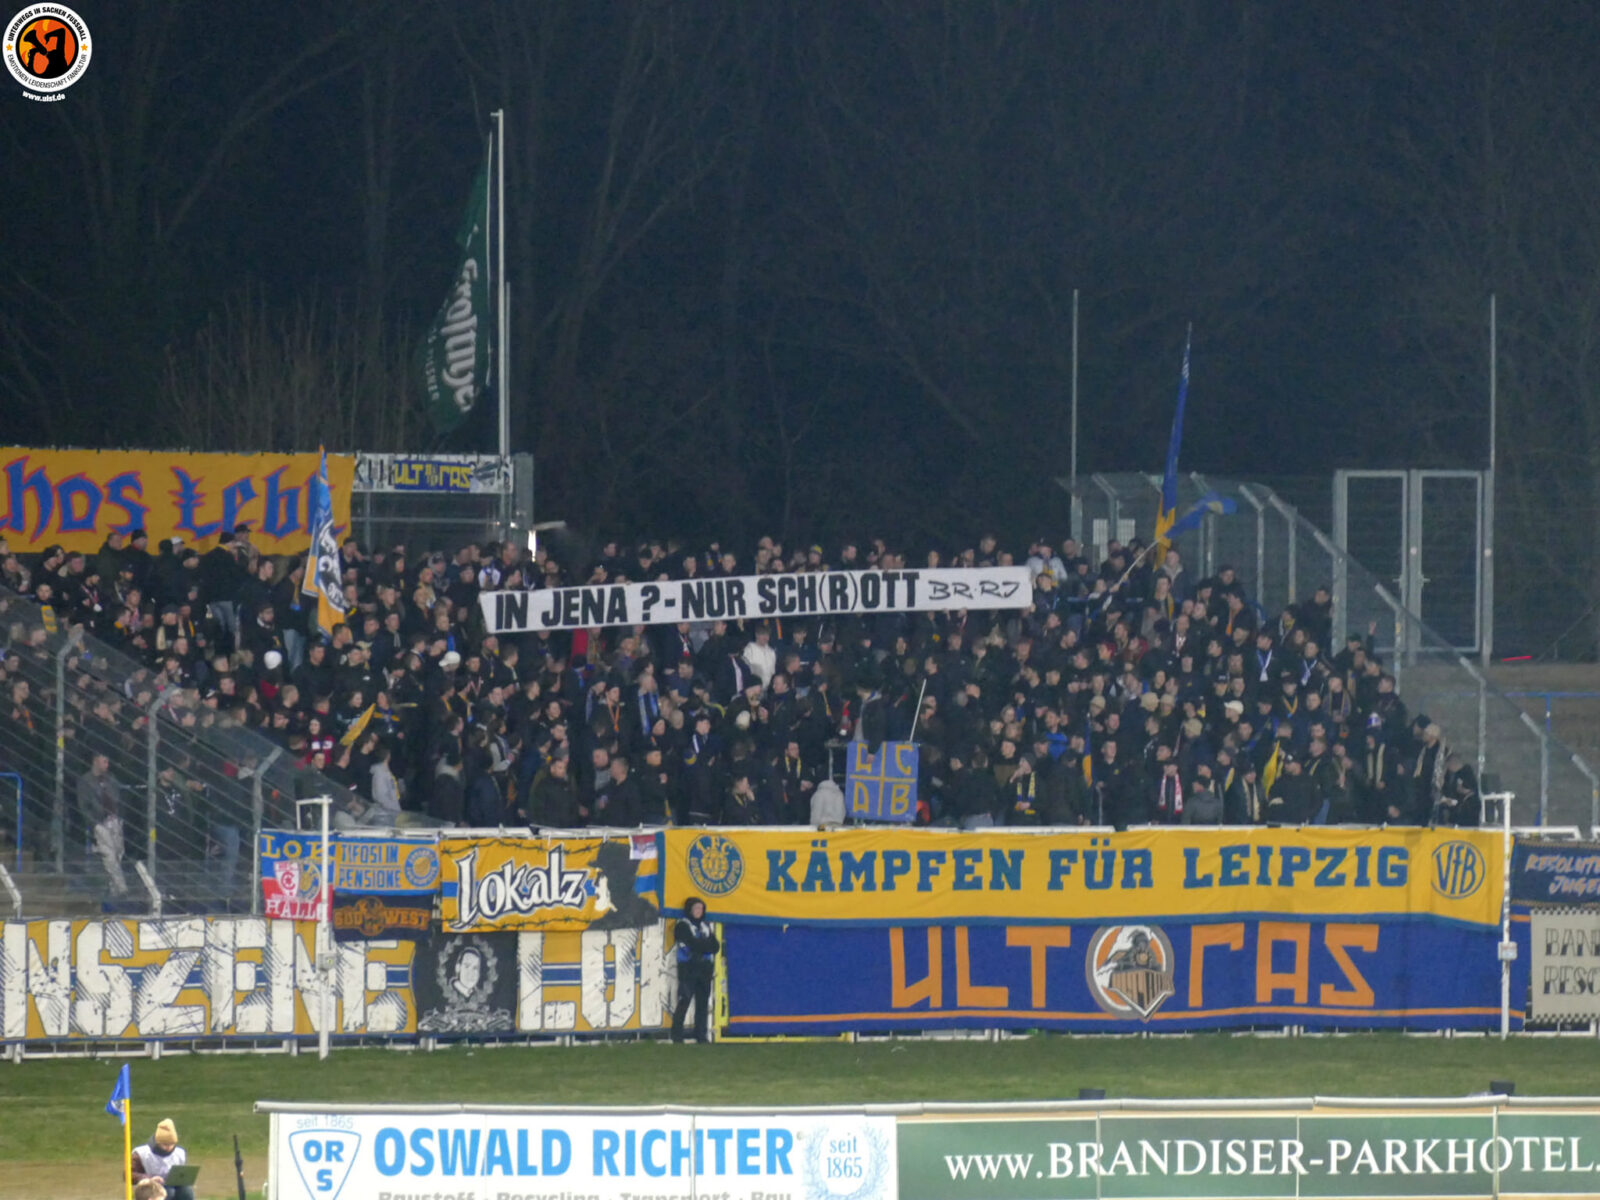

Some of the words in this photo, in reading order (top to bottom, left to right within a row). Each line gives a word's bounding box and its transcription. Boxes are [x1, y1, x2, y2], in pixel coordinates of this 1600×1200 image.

[0, 456, 151, 543] hos
[495, 593, 529, 630] IN
[541, 586, 628, 627] JENA
[757, 571, 920, 615] SCH(R)OTT
[341, 843, 383, 863] TIFOSI
[765, 839, 1025, 893] KÄMPFEN
[1047, 838, 1154, 891] FÜR
[1183, 843, 1409, 889] LEIPZIG
[1435, 844, 1477, 895] VfB
[339, 868, 402, 888] PENSIONE
[1549, 875, 1600, 896] JUGE
[303, 1139, 345, 1163] OR
[374, 1127, 572, 1177] OSWALD
[592, 1128, 794, 1177] RICHTER
[829, 1134, 857, 1154] seit
[826, 1157, 863, 1179] 1865
[316, 1169, 333, 1192] S
